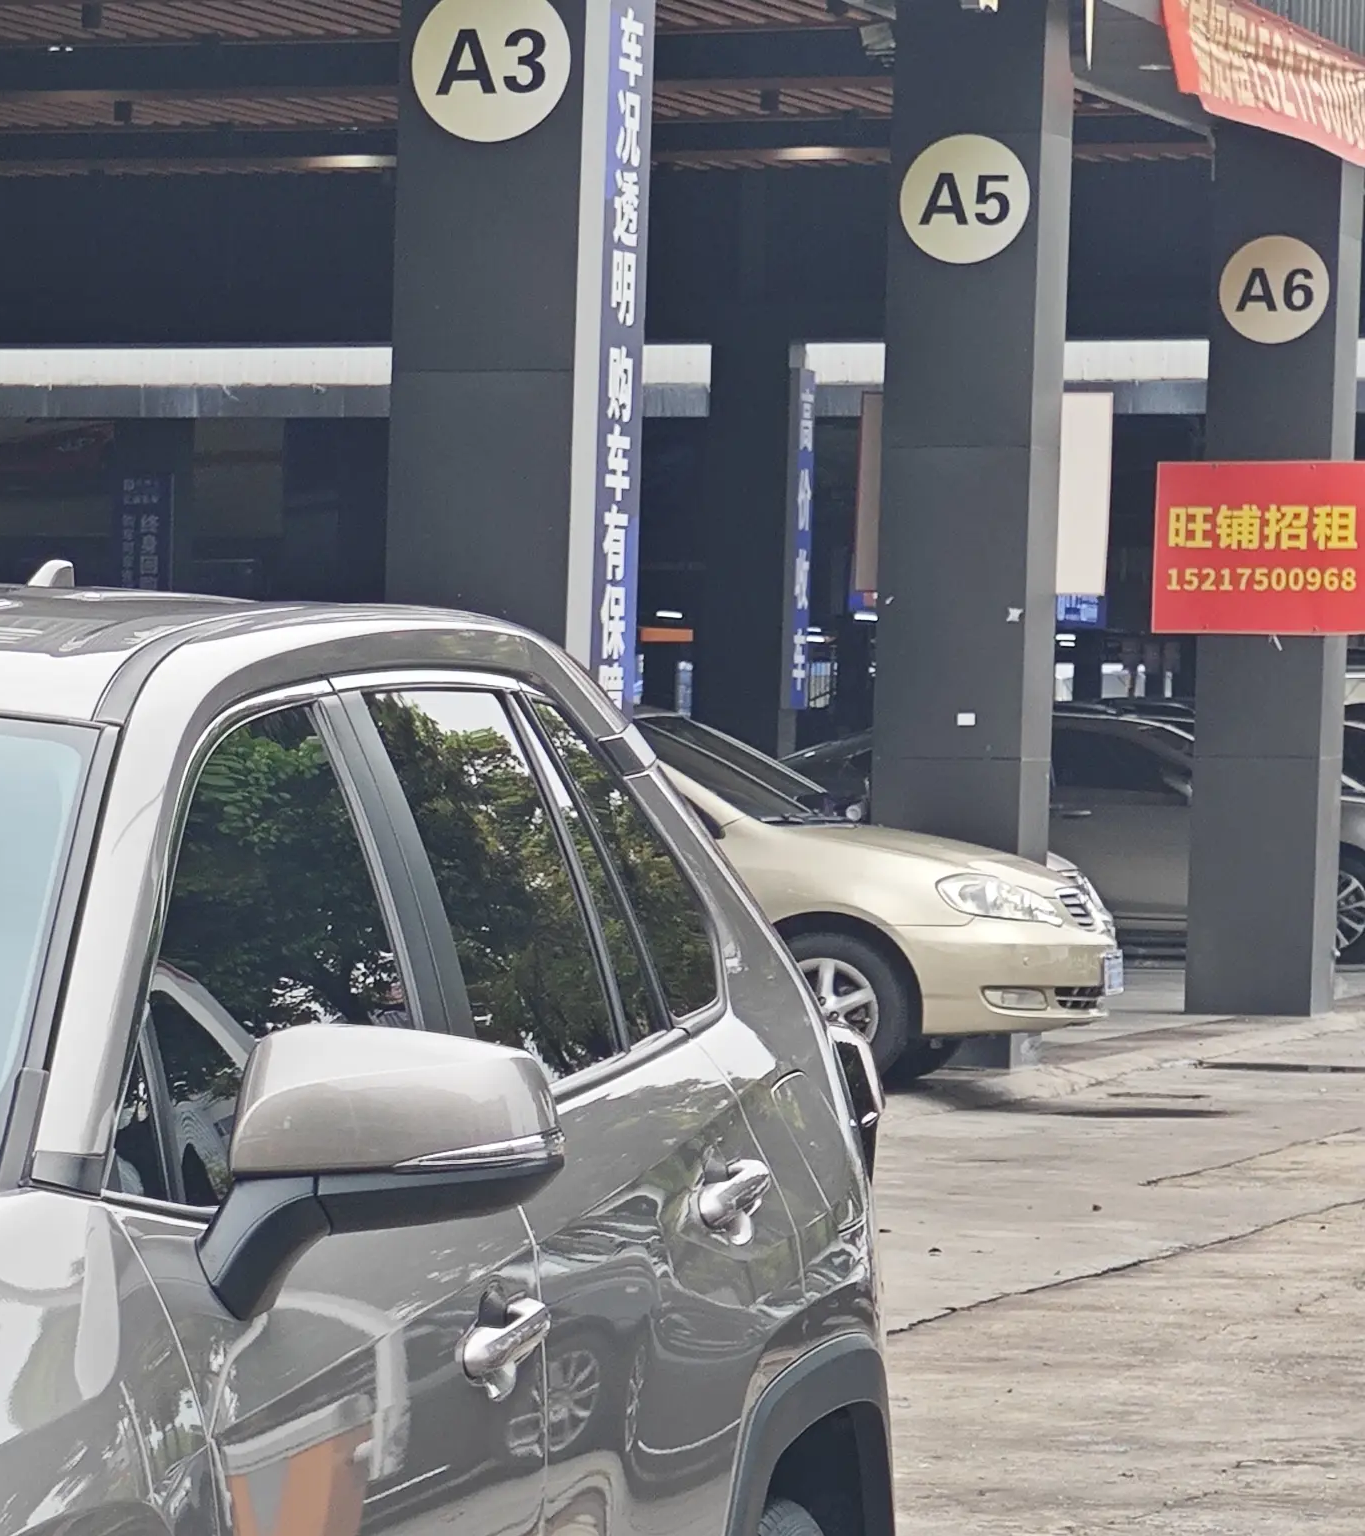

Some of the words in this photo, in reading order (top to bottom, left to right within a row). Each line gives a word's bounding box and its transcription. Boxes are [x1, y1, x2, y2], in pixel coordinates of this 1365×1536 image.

[435, 28, 547, 97] A3
[610, 8, 644, 325] 车况透明
[918, 173, 1010, 226] A5
[1235, 267, 1314, 313] A6
[1167, 505, 1357, 550] 旺铺招租
[1166, 567, 1356, 592] 15217500968
